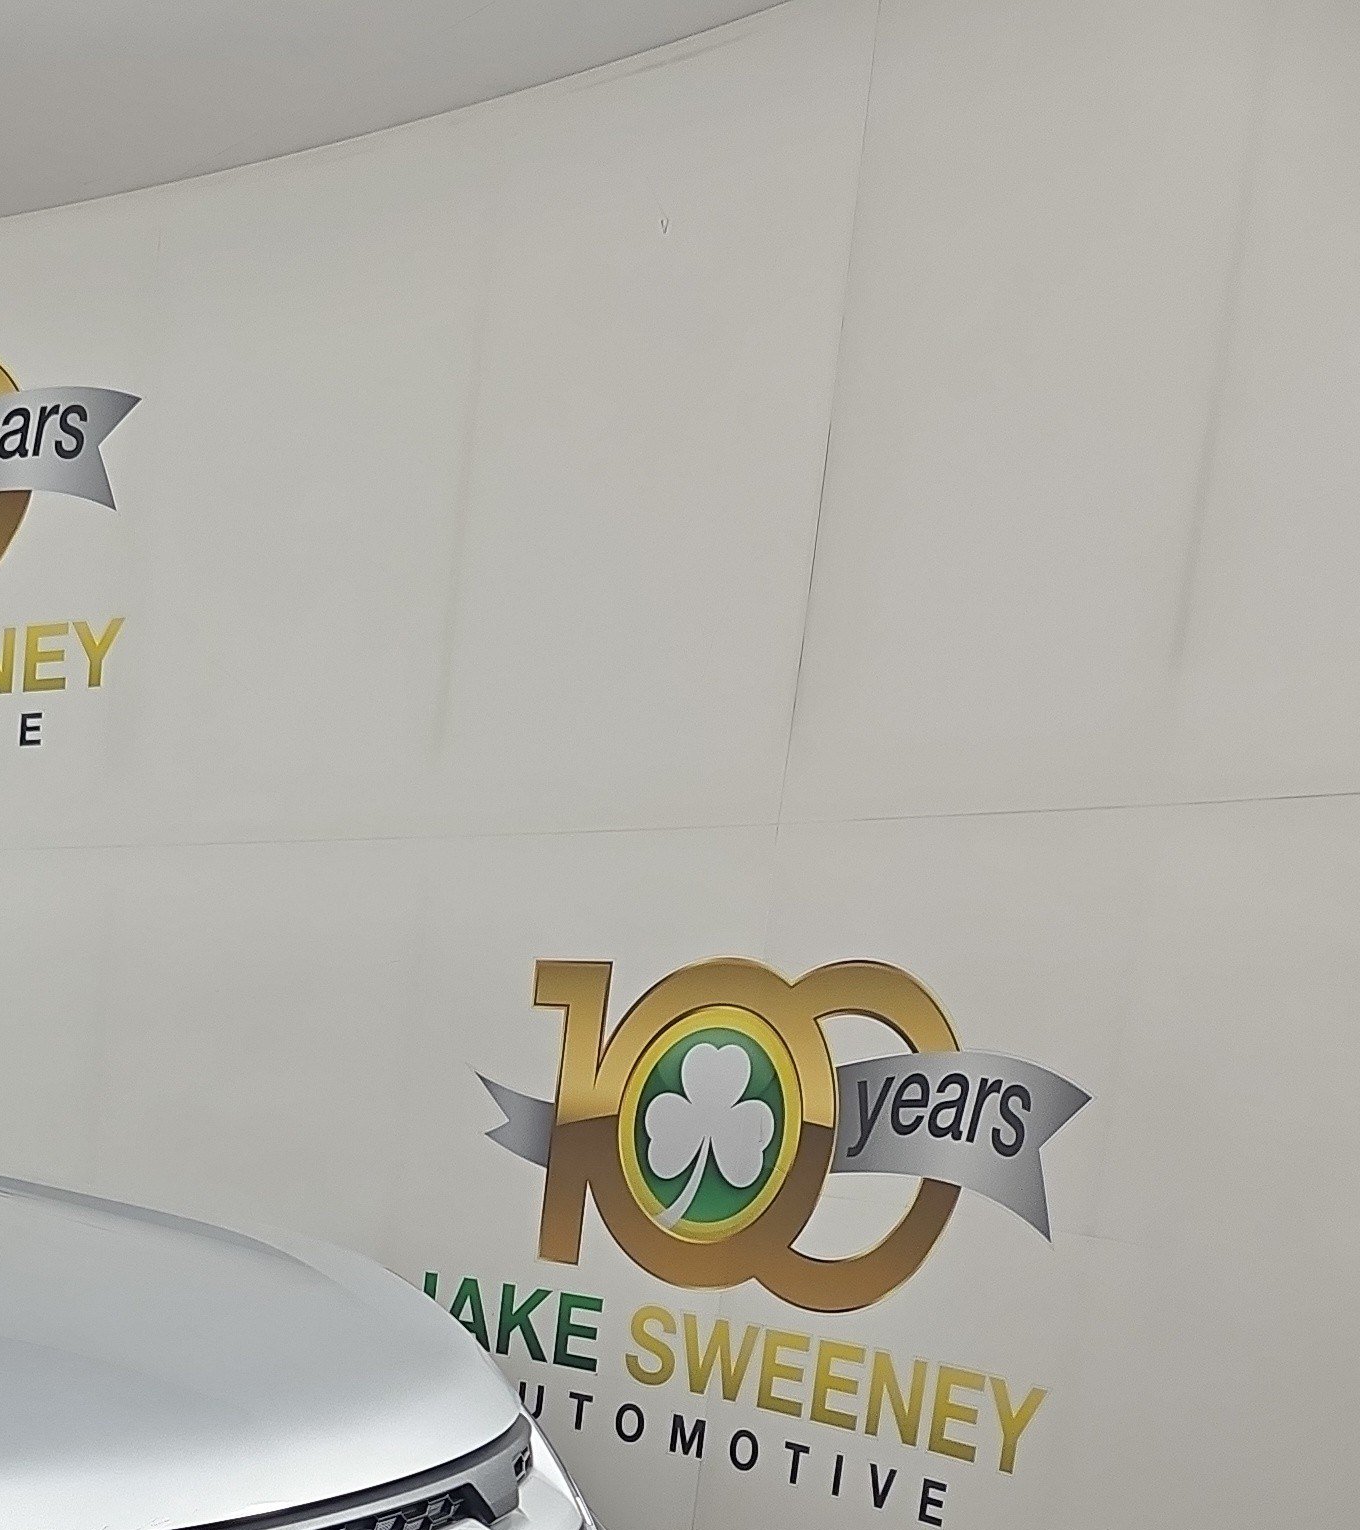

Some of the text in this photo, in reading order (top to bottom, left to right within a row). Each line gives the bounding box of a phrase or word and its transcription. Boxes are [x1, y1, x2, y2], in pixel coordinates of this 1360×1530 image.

[533, 958, 1032, 1314] 100 years
[423, 1271, 1048, 1475] AKE SWEENEY
[518, 1381, 948, 1528] UTOMOTIVE
